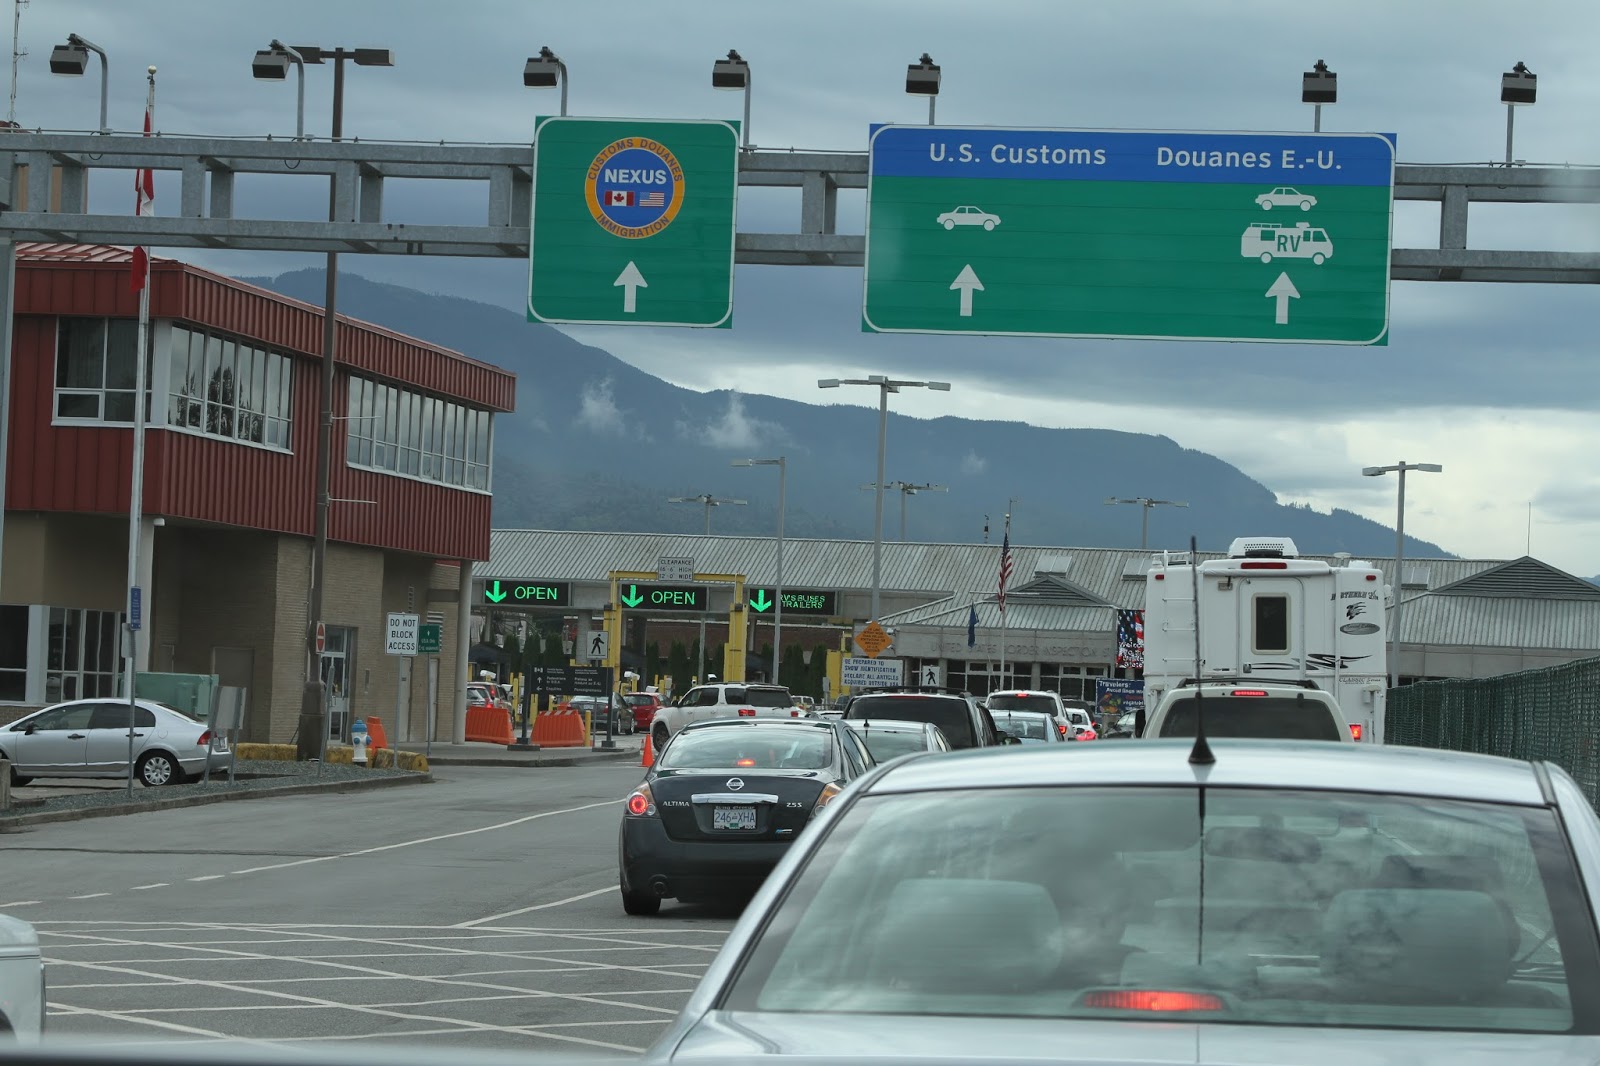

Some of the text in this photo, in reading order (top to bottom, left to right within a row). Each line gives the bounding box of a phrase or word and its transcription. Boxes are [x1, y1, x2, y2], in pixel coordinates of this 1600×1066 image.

[588, 139, 682, 182] CUSTOMS DOUANES
[929, 143, 1106, 165] U.S. Customs
[1156, 146, 1342, 169] Douanes E.-U.
[604, 168, 667, 184] NEXUS
[597, 214, 670, 238] IMMIGRATION
[1277, 234, 1301, 253] RV
[514, 586, 558, 600] OPEN
[651, 590, 695, 605] OPEN
[797, 594, 826, 602] BUSES
[1330, 591, 1368, 601] NRTHERN
[782, 601, 823, 609] TRAILERS
[390, 618, 416, 627] DO NOT
[391, 630, 414, 639] BLOCK
[388, 641, 415, 650] ACCESS
[715, 811, 756, 823] 246 XHA
